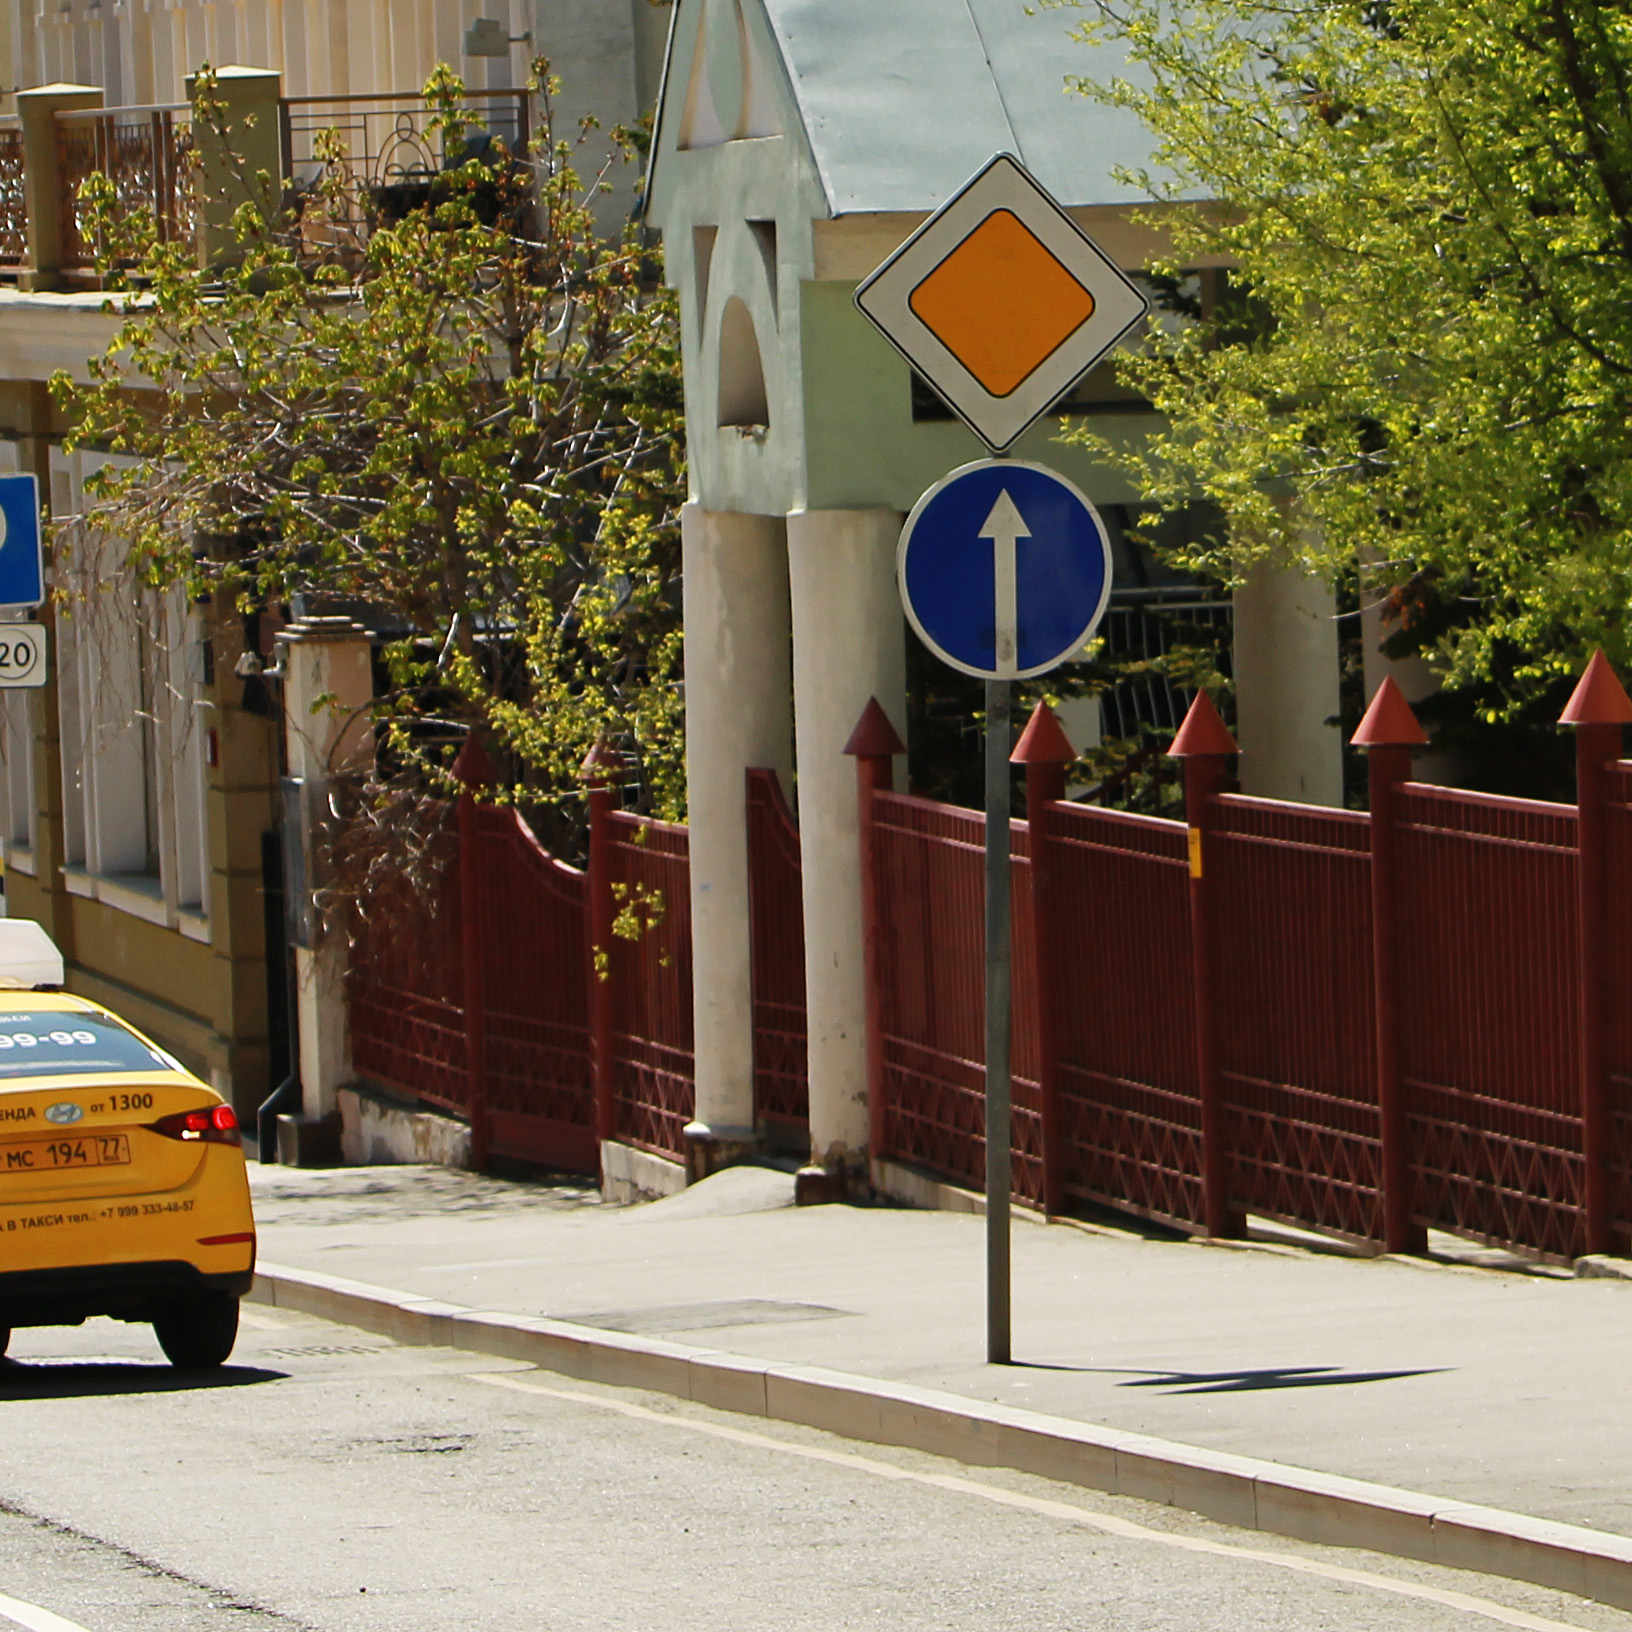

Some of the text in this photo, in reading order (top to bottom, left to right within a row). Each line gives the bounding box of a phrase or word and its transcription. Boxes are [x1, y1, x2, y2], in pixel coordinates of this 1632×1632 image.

[90, 1102, 105, 1113] от
[109, 1093, 154, 1111] 1300
[47, 1142, 88, 1165] 194
[98, 1137, 120, 1155] 77
[7, 1219, 17, 1231] В
[20, 1213, 64, 1229] ТАКСИ
